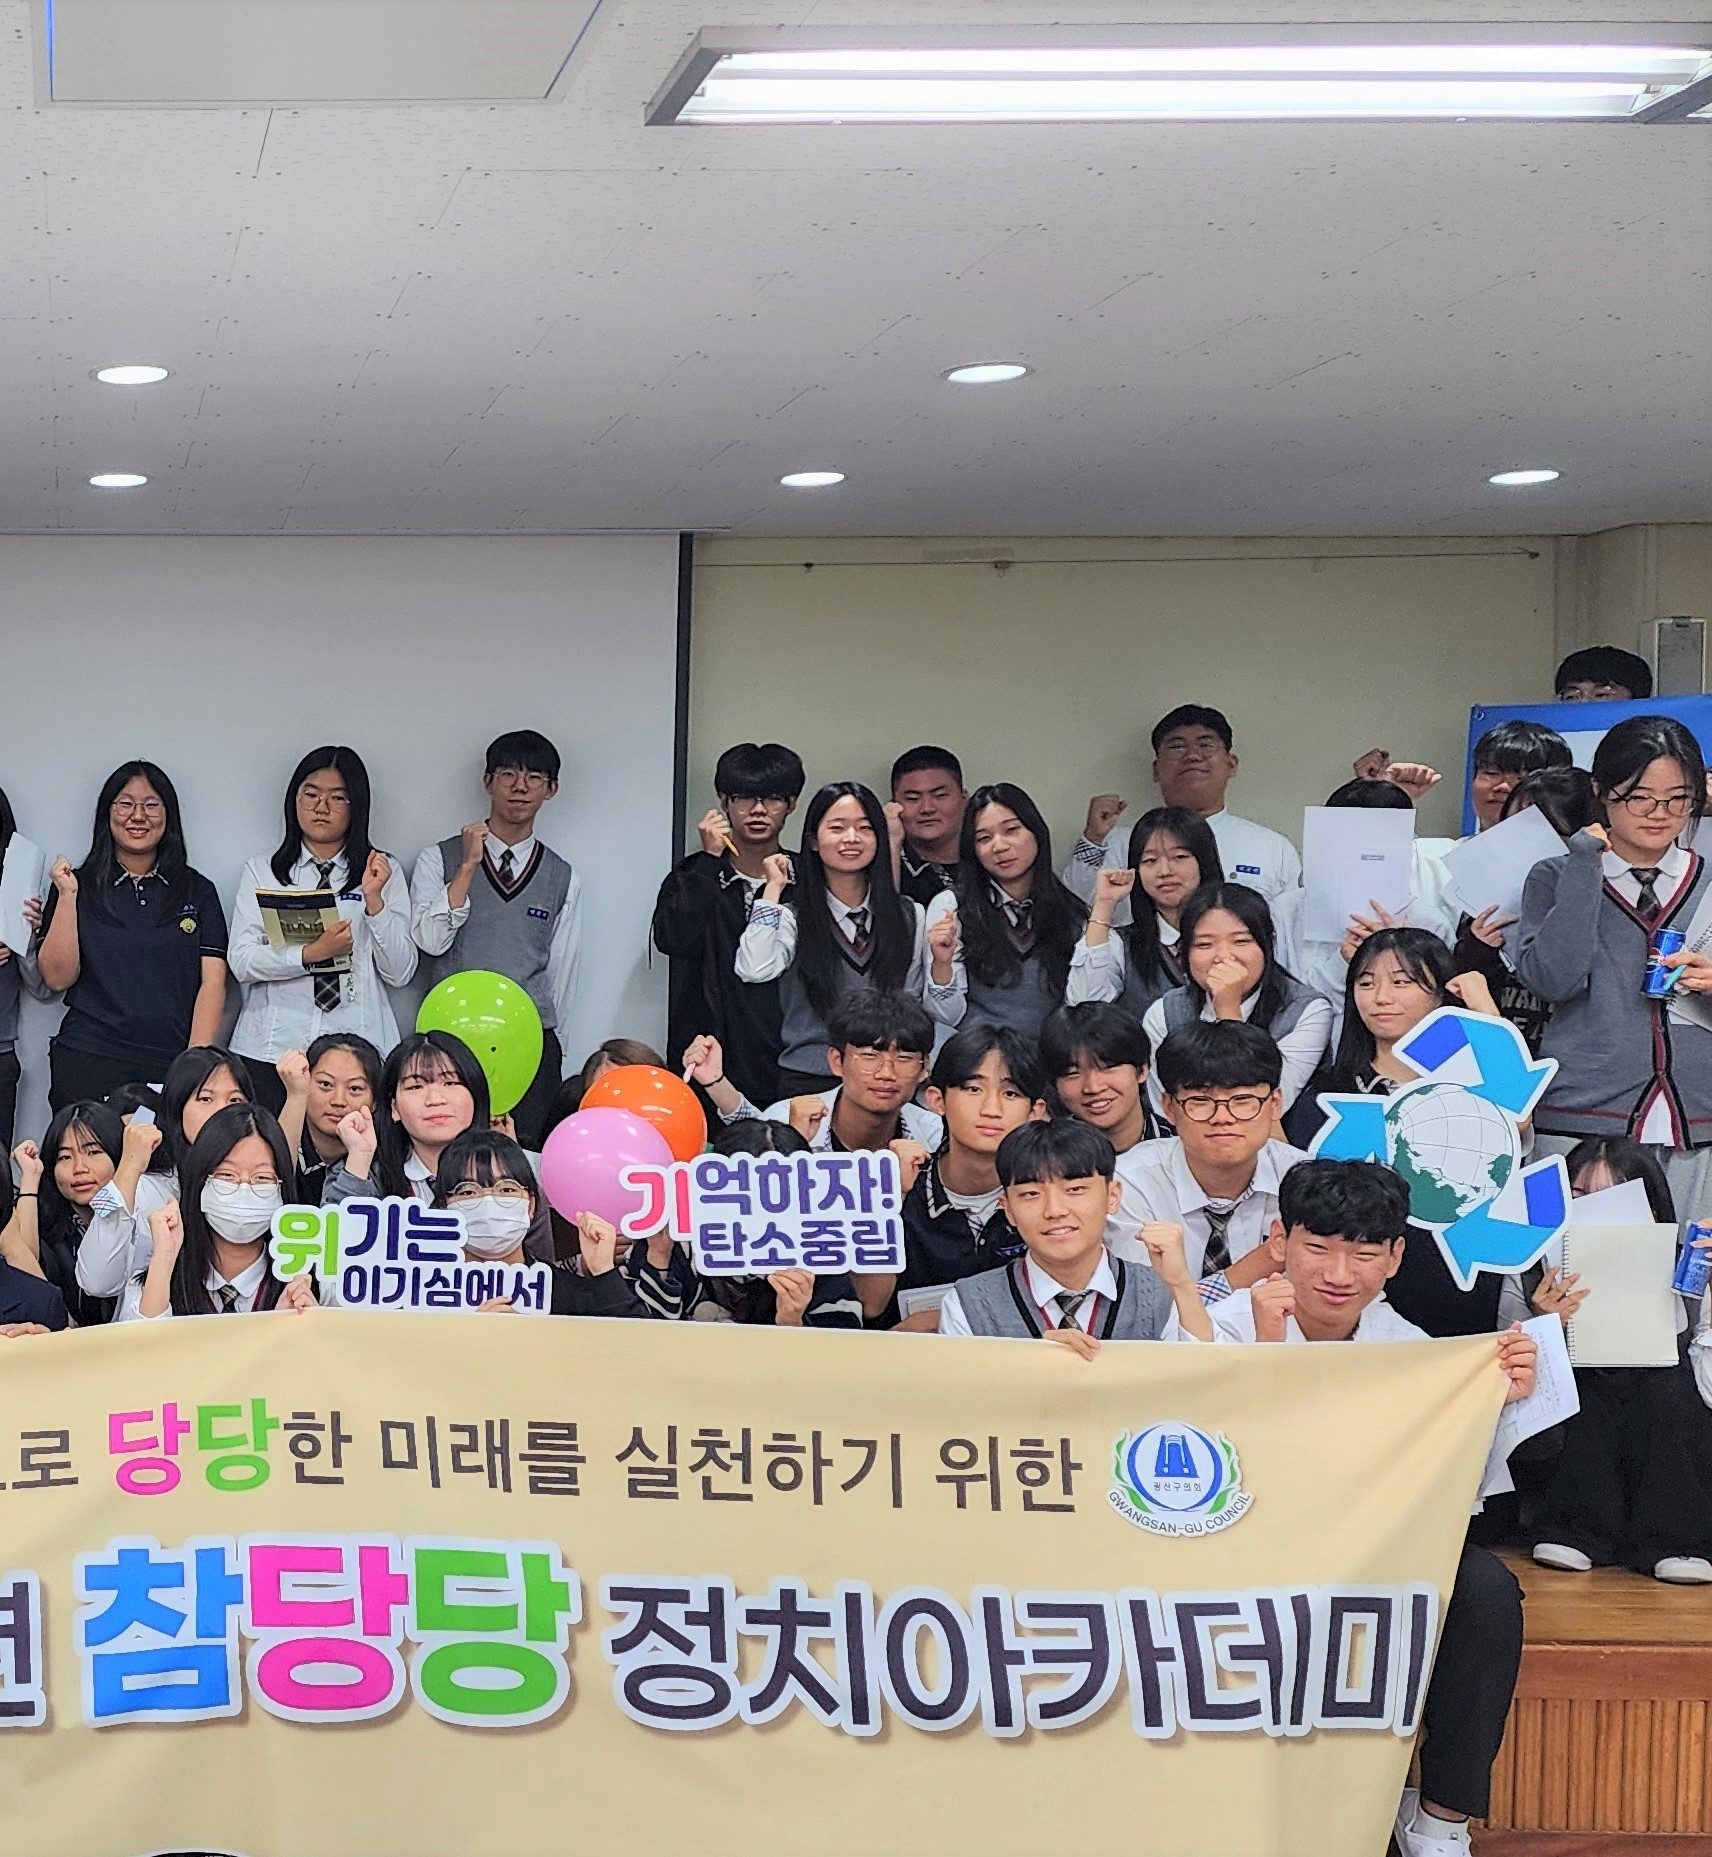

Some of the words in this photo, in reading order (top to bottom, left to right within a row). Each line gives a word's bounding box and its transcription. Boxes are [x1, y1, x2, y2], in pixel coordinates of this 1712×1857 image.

[627, 1156, 895, 1233] 기억하자!
[277, 1203, 461, 1276] 위기는
[699, 1218, 899, 1268] 탄소중립
[343, 1264, 546, 1310] 이기심에서
[108, 1398, 352, 1496] 당당한
[381, 1416, 587, 1498] 미래를
[615, 1424, 903, 1508] 실천하기
[936, 1436, 1082, 1513] 위한
[1109, 1491, 1203, 1533] GWANGSAN-GU
[1205, 1494, 1251, 1530] COUNCIL
[1152, 1481, 1202, 1492] 광산구의회
[85, 1543, 571, 1719] 참당당
[608, 1584, 1429, 1729] 정치아카데미
